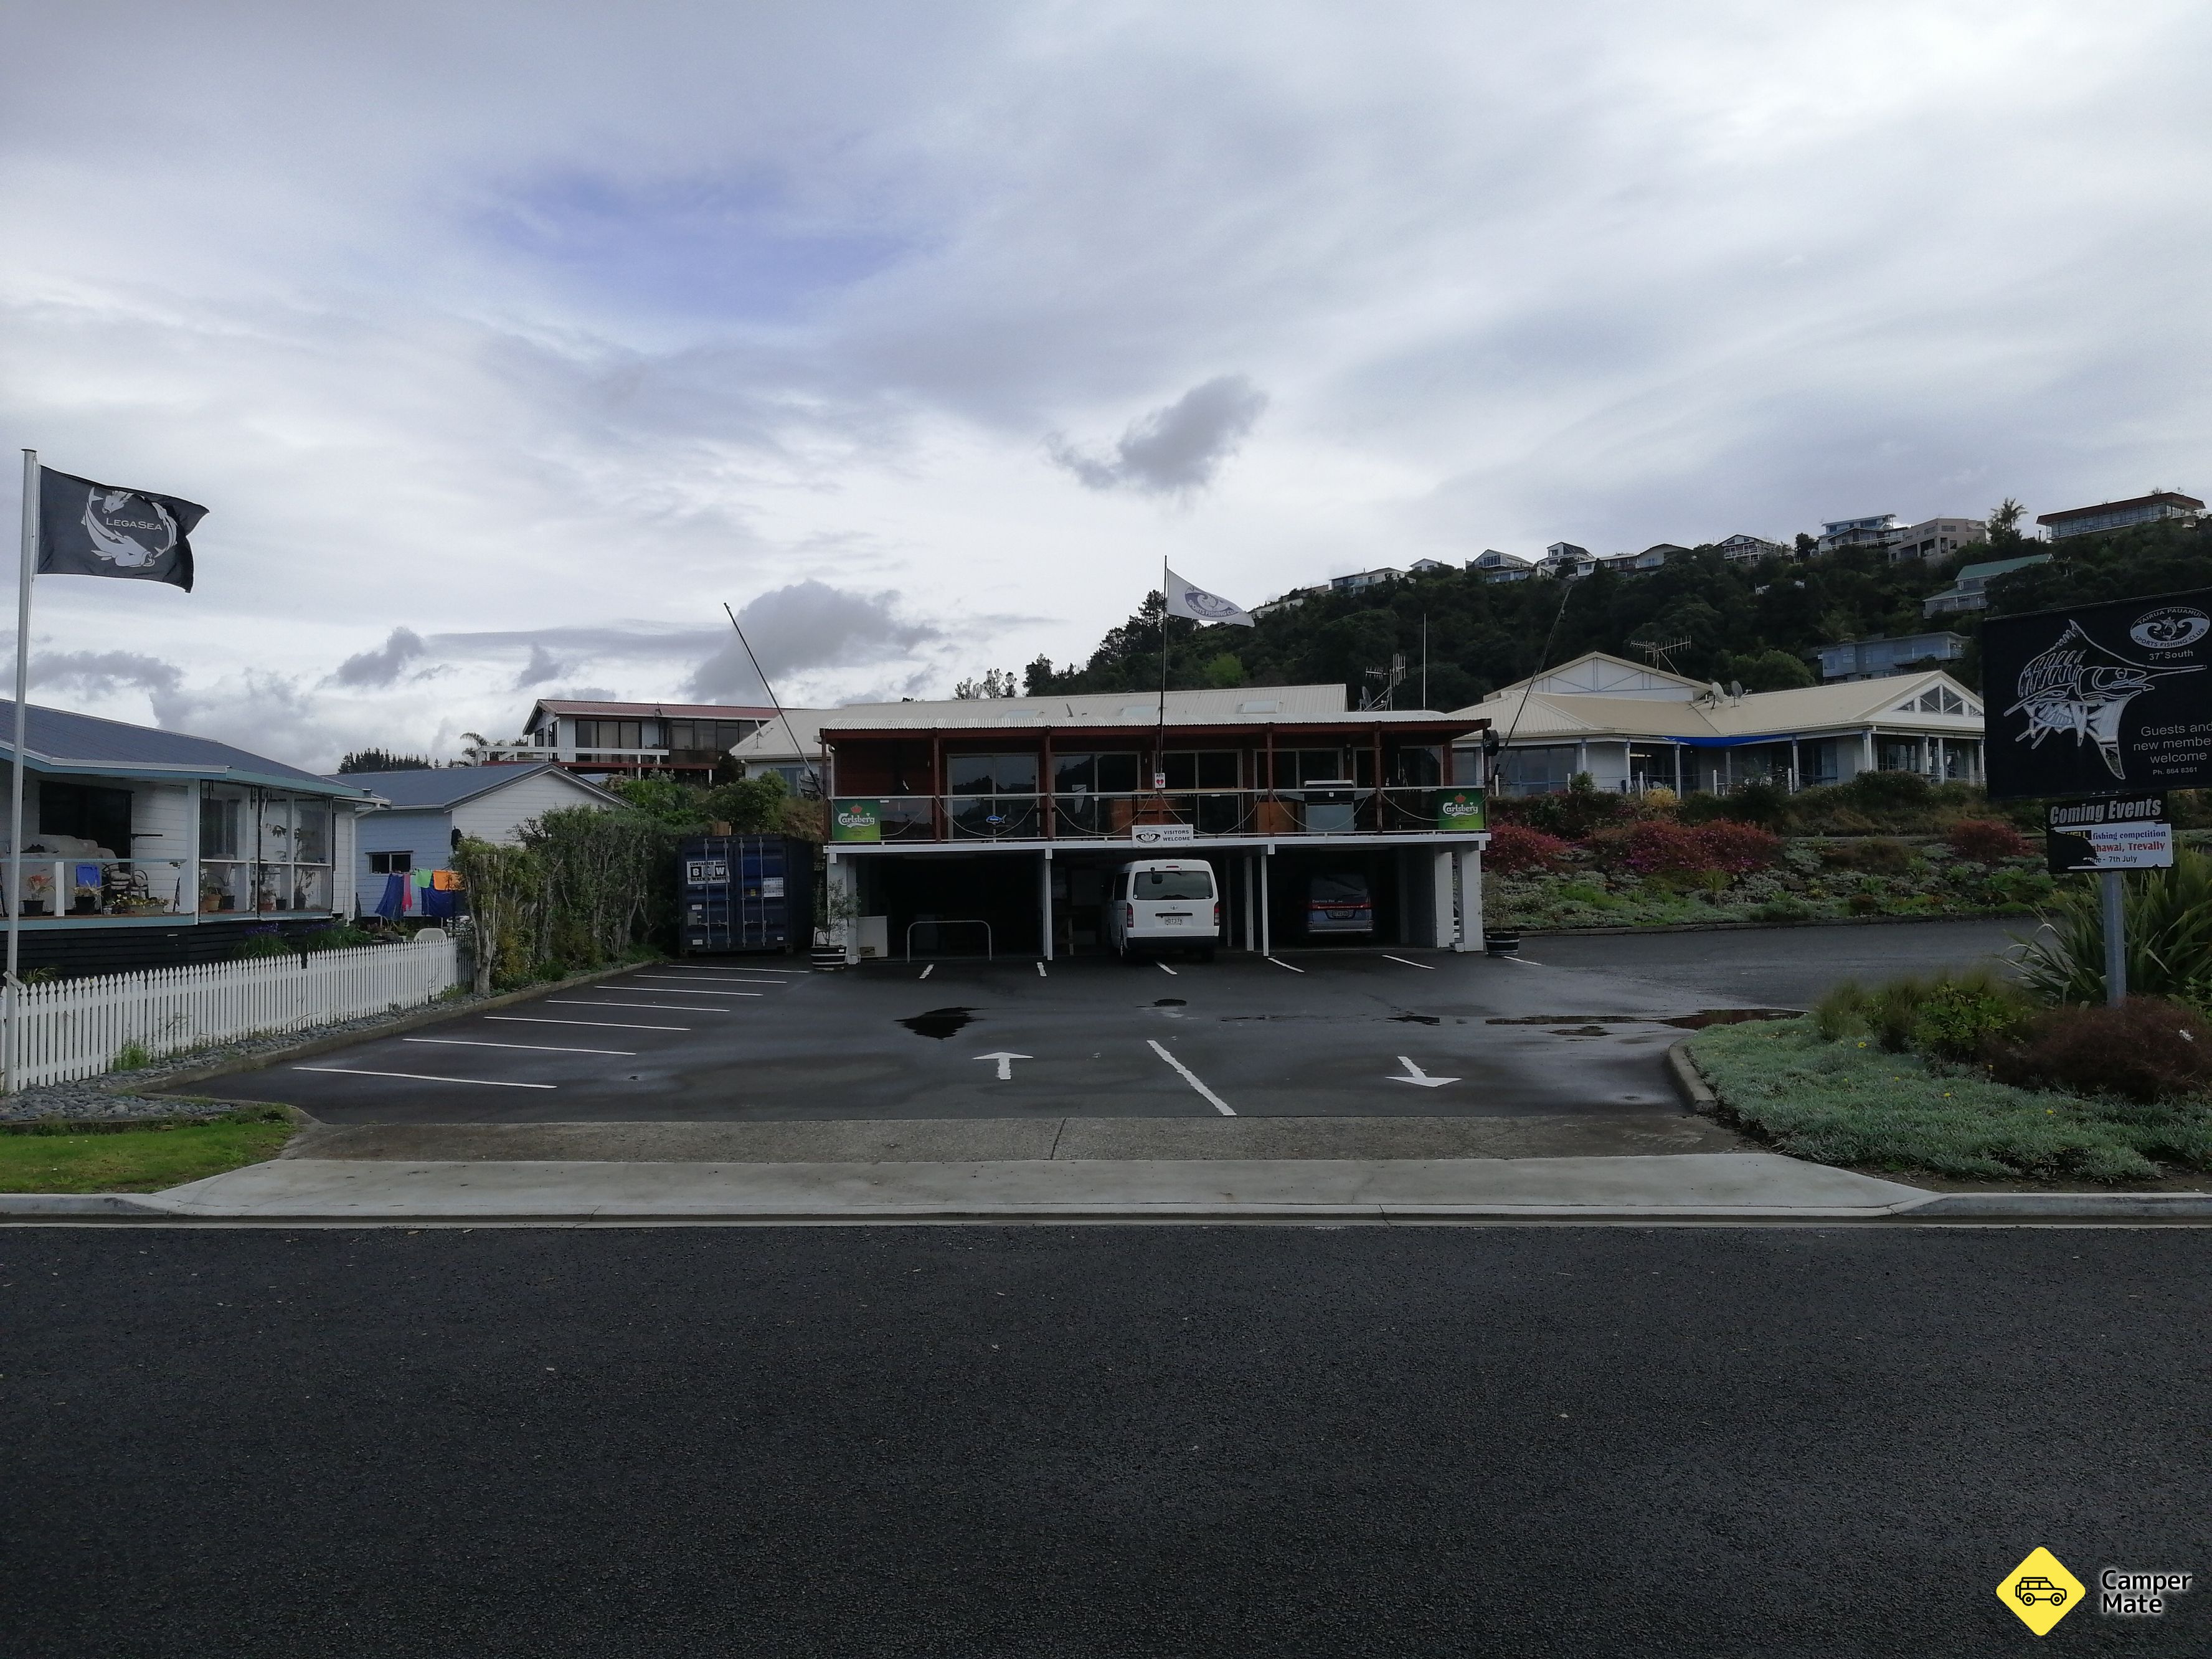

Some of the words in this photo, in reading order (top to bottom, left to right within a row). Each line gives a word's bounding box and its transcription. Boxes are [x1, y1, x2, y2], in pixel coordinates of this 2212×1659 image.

[1188, 600, 1205, 614] SPORTS
[2137, 610, 2165, 624] TAIRUA
[2167, 608, 2202, 617] PAUANUI
[2134, 635, 2158, 647] SPORTS
[2160, 638, 2188, 647] FISHING
[2189, 628, 2205, 640] CLUB
[2141, 724, 2186, 736] Guests
[2134, 742, 2159, 751] new
[2163, 736, 2212, 749] membe
[2150, 752, 2207, 763] welcome
[1443, 802, 1478, 816] Carlsberg
[2049, 803, 2105, 825] Coming
[2108, 798, 2162, 820] Events
[838, 813, 875, 828] Carlsberg
[2093, 832, 2117, 841] fishing
[2119, 830, 2167, 839] competition
[2092, 843, 2125, 853] ahawai,
[2128, 841, 2165, 851] Trevally
[692, 868, 699, 876] B
[716, 867, 725, 875] W
